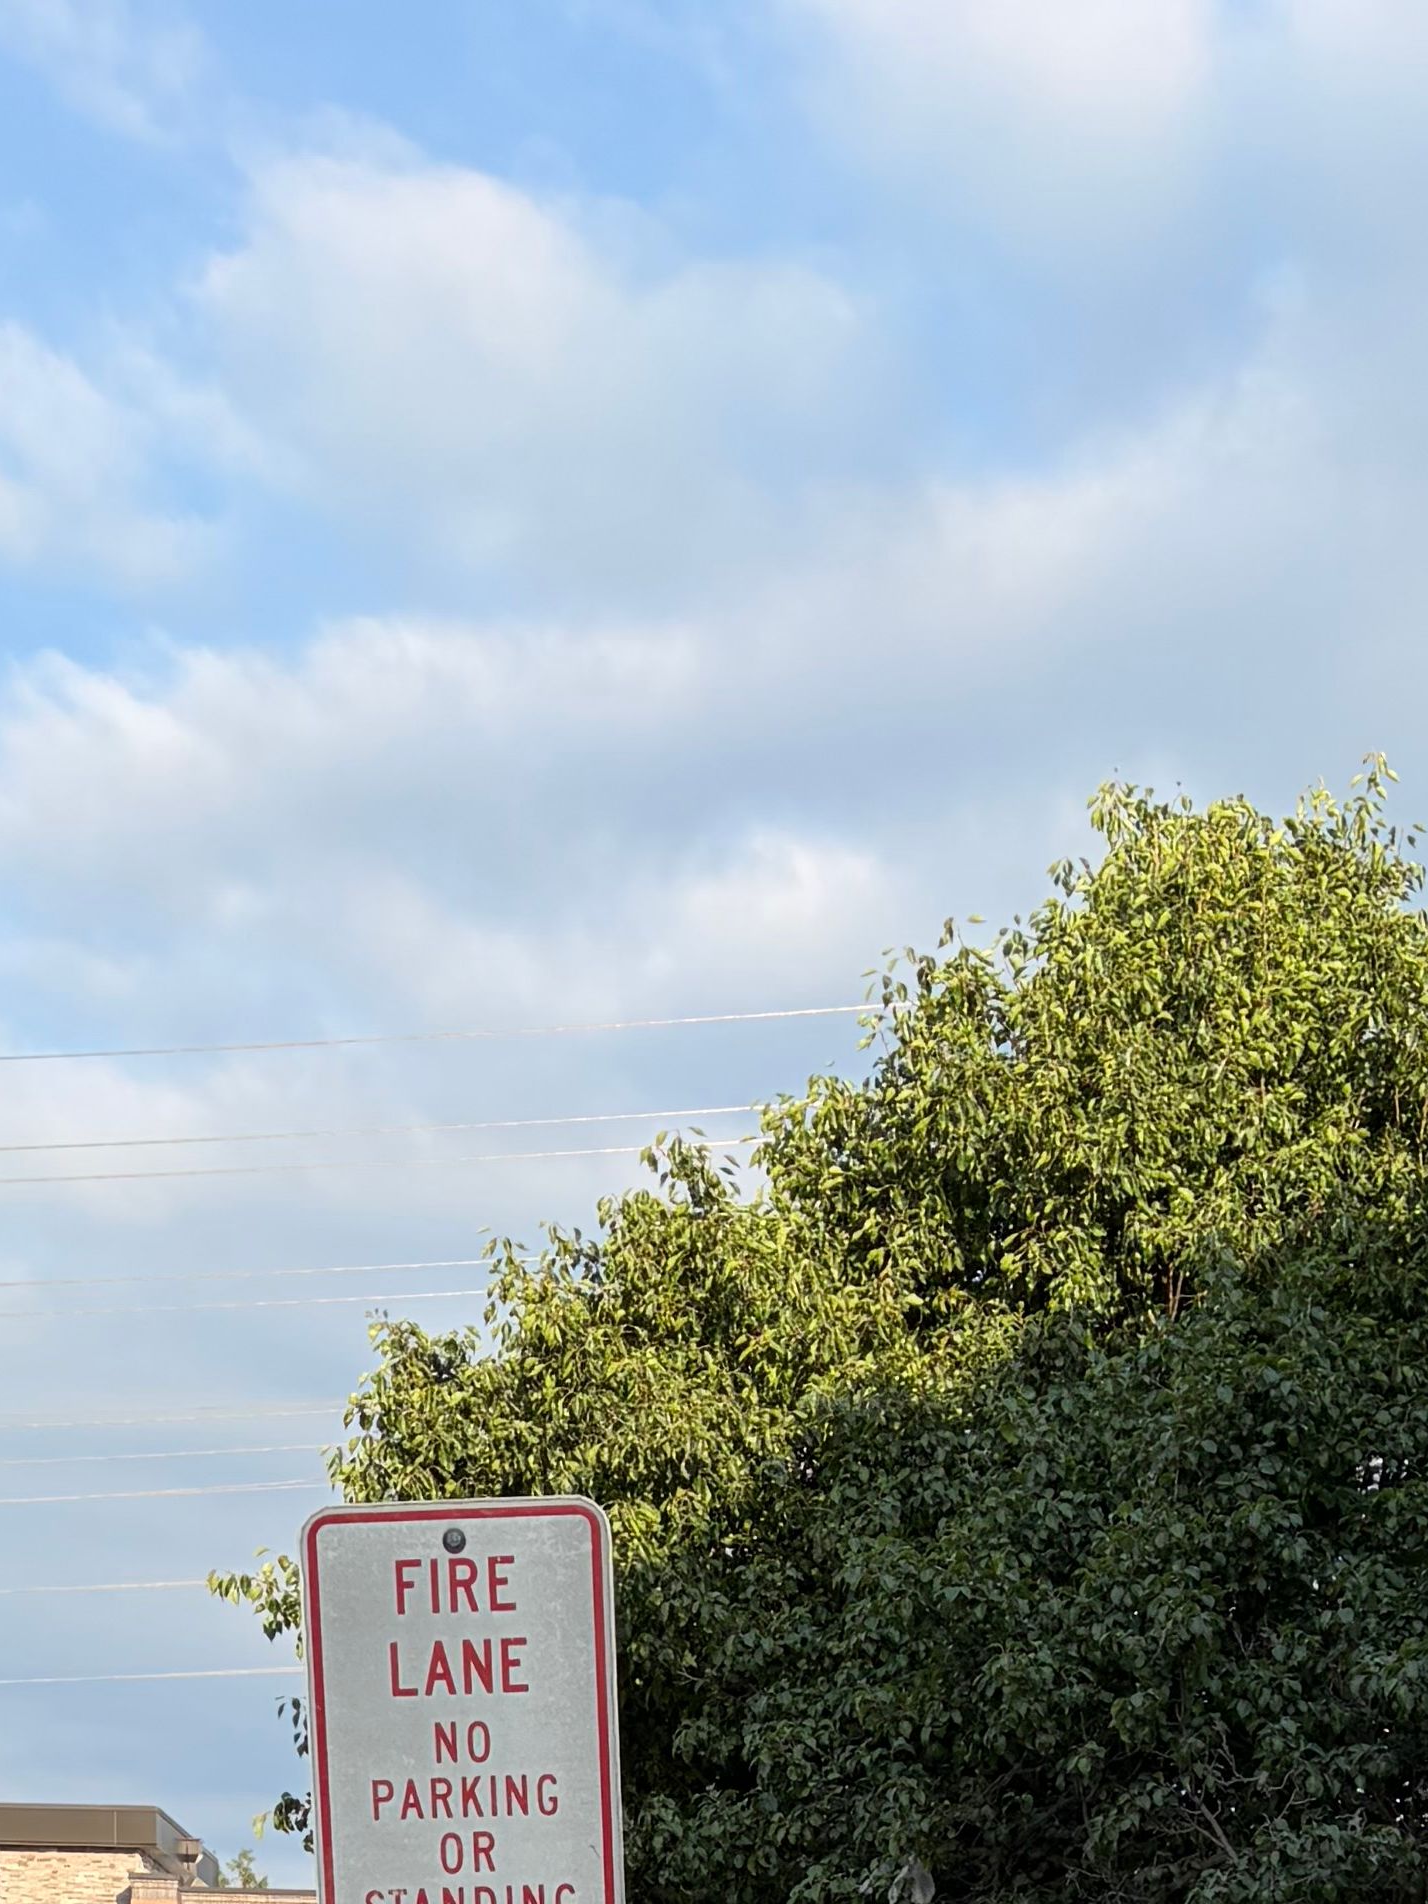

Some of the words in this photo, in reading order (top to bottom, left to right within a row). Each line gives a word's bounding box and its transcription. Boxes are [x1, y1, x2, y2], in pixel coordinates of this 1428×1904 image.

[394, 1555, 516, 1615] FIRE
[389, 1637, 529, 1697] LANE
[433, 1721, 491, 1764] NO
[371, 1773, 558, 1820] PARKING
[440, 1831, 495, 1875] OR
